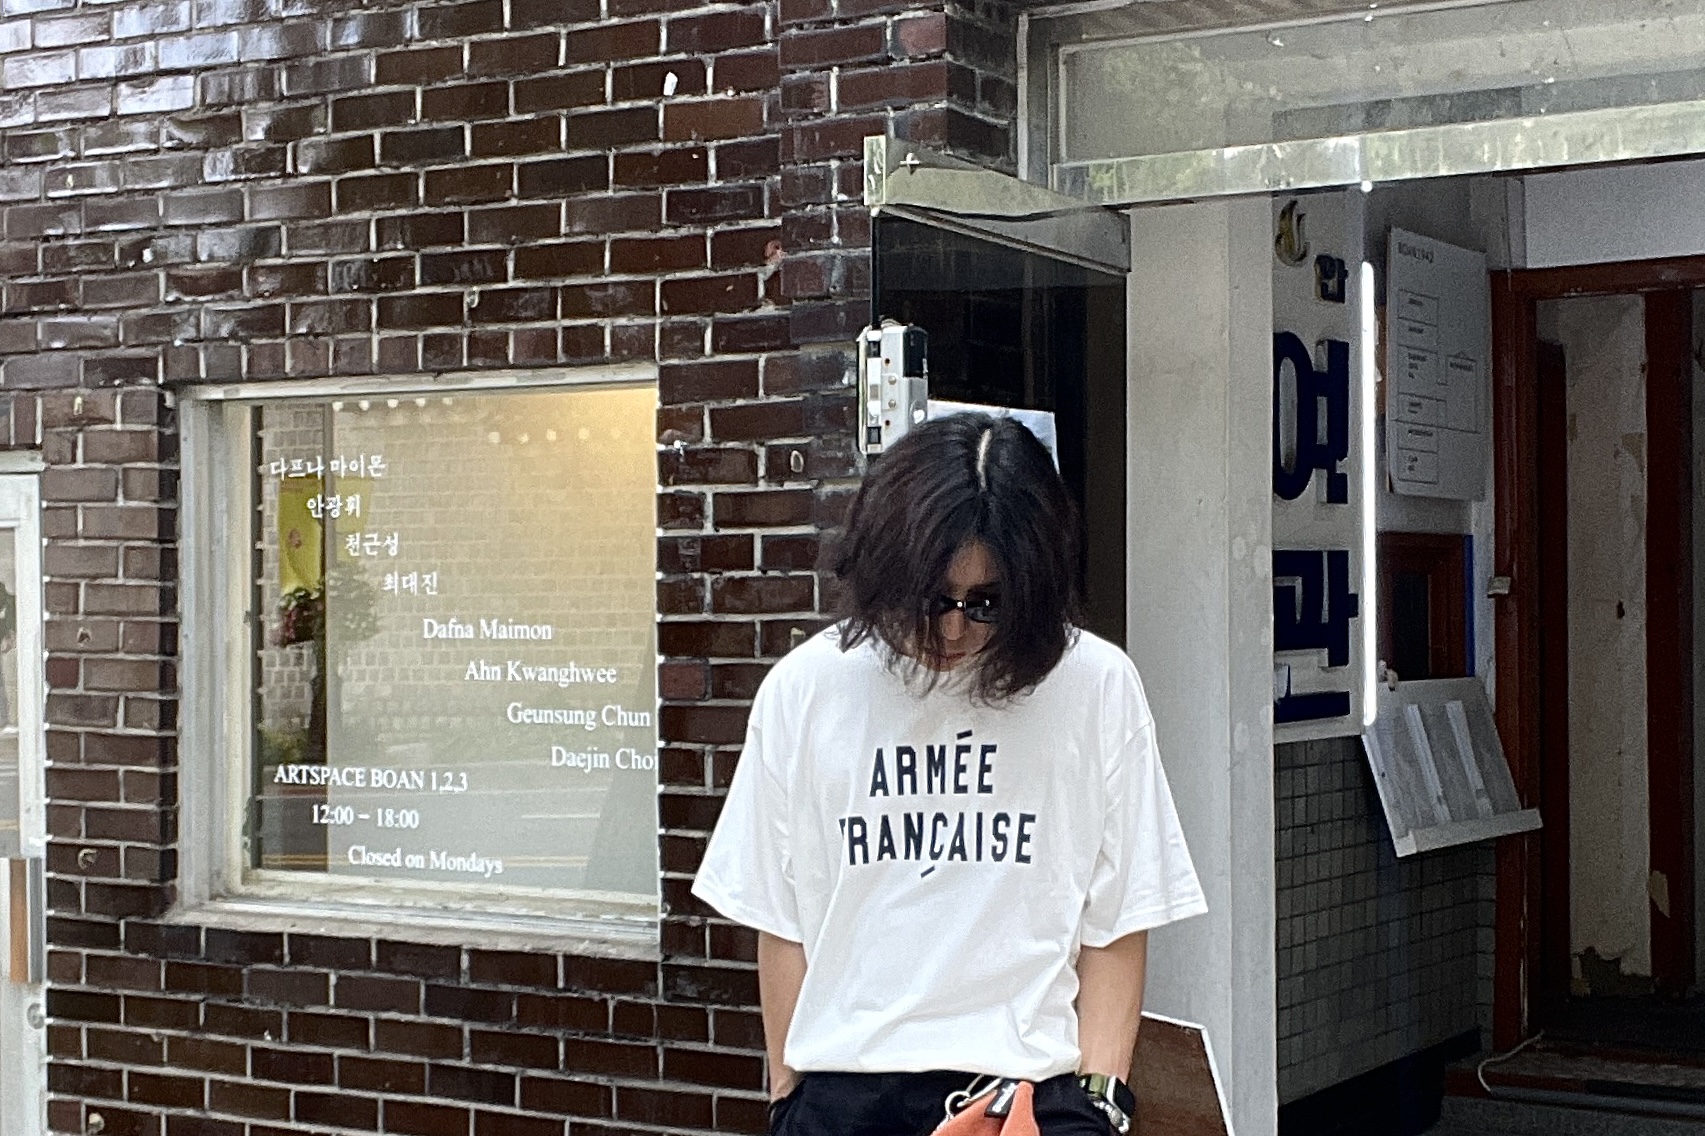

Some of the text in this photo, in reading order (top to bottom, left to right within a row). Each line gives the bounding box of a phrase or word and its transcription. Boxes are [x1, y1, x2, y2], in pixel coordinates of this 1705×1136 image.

[270, 454, 387, 481] 다프나 마이몬
[306, 494, 361, 519] 안광휘
[344, 532, 399, 557] 천근성
[382, 571, 438, 596] 최대진
[423, 617, 552, 640] Dafna Maimon
[465, 660, 617, 688] Ahn Kwanghwee
[507, 702, 652, 731] Geunsung Chun
[551, 746, 610, 774] Daejin
[869, 729, 998, 797] ARMÉE
[273, 764, 367, 788] ARTSPACE
[370, 769, 425, 790] BOAN
[312, 804, 354, 825] 12:00
[377, 807, 419, 829] 18:00
[838, 811, 1036, 879] RANÇAISE
[348, 845, 503, 878] Closed on Mondays
